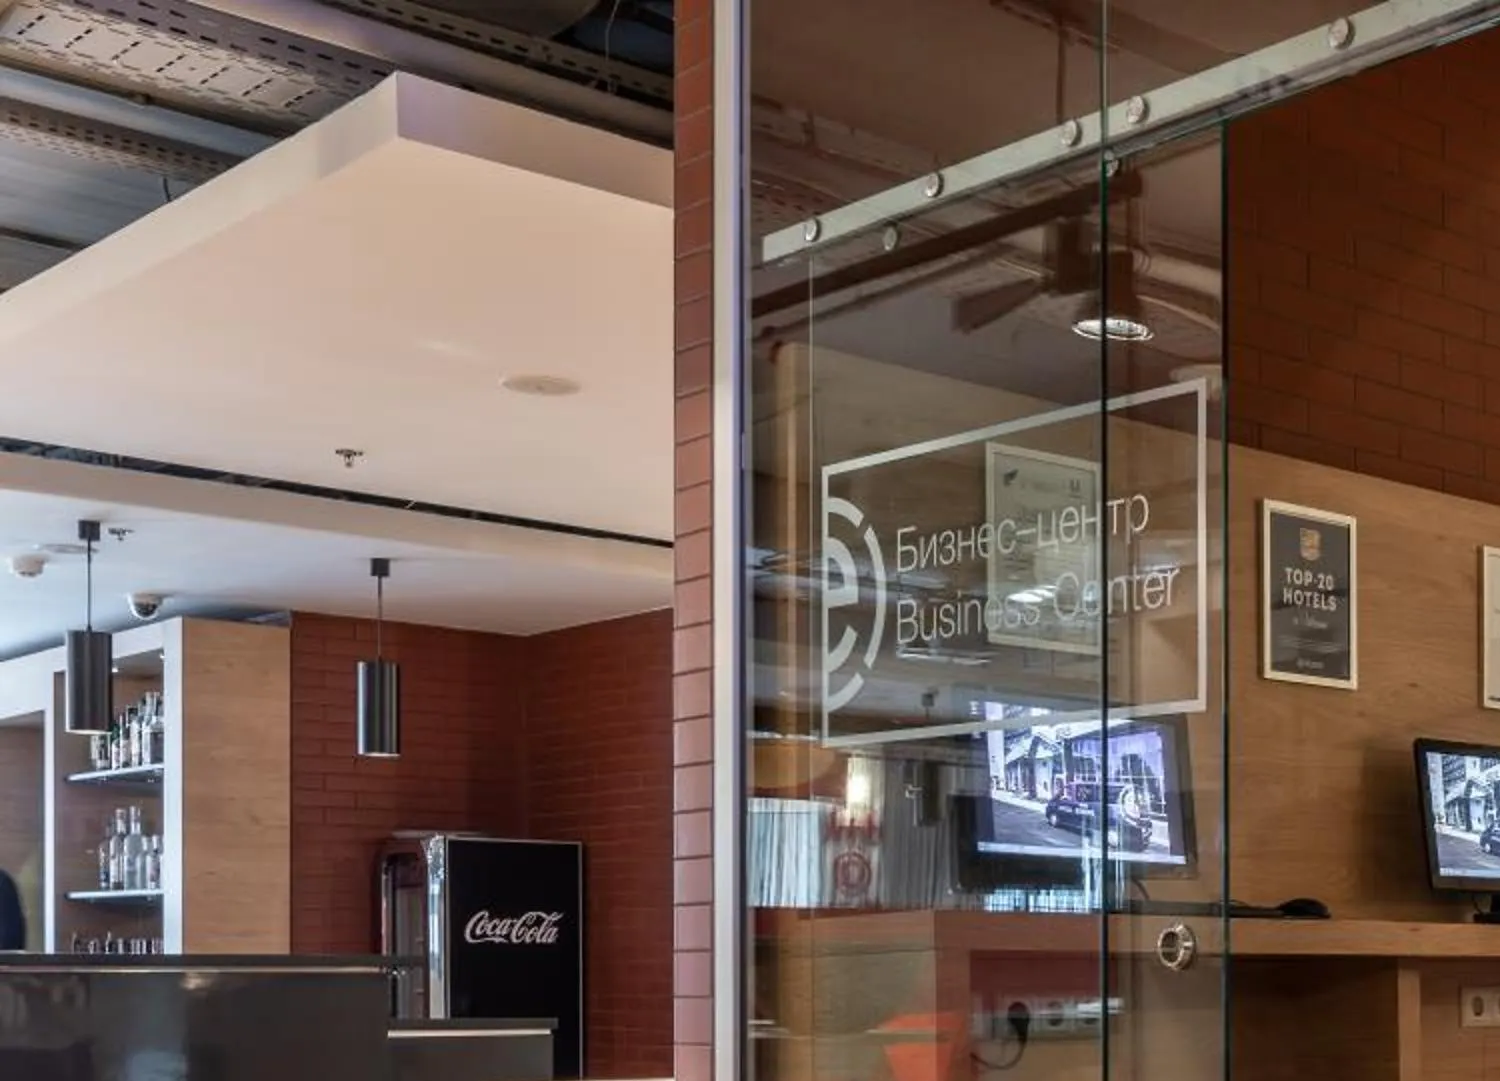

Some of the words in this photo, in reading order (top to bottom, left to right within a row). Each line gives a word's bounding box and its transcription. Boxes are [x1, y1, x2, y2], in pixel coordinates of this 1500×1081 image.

[896, 493, 1150, 572] Бизнес-центр
[897, 590, 1041, 646] Business
[1053, 564, 1180, 622] Center
[1282, 587, 1337, 612] HOTELS
